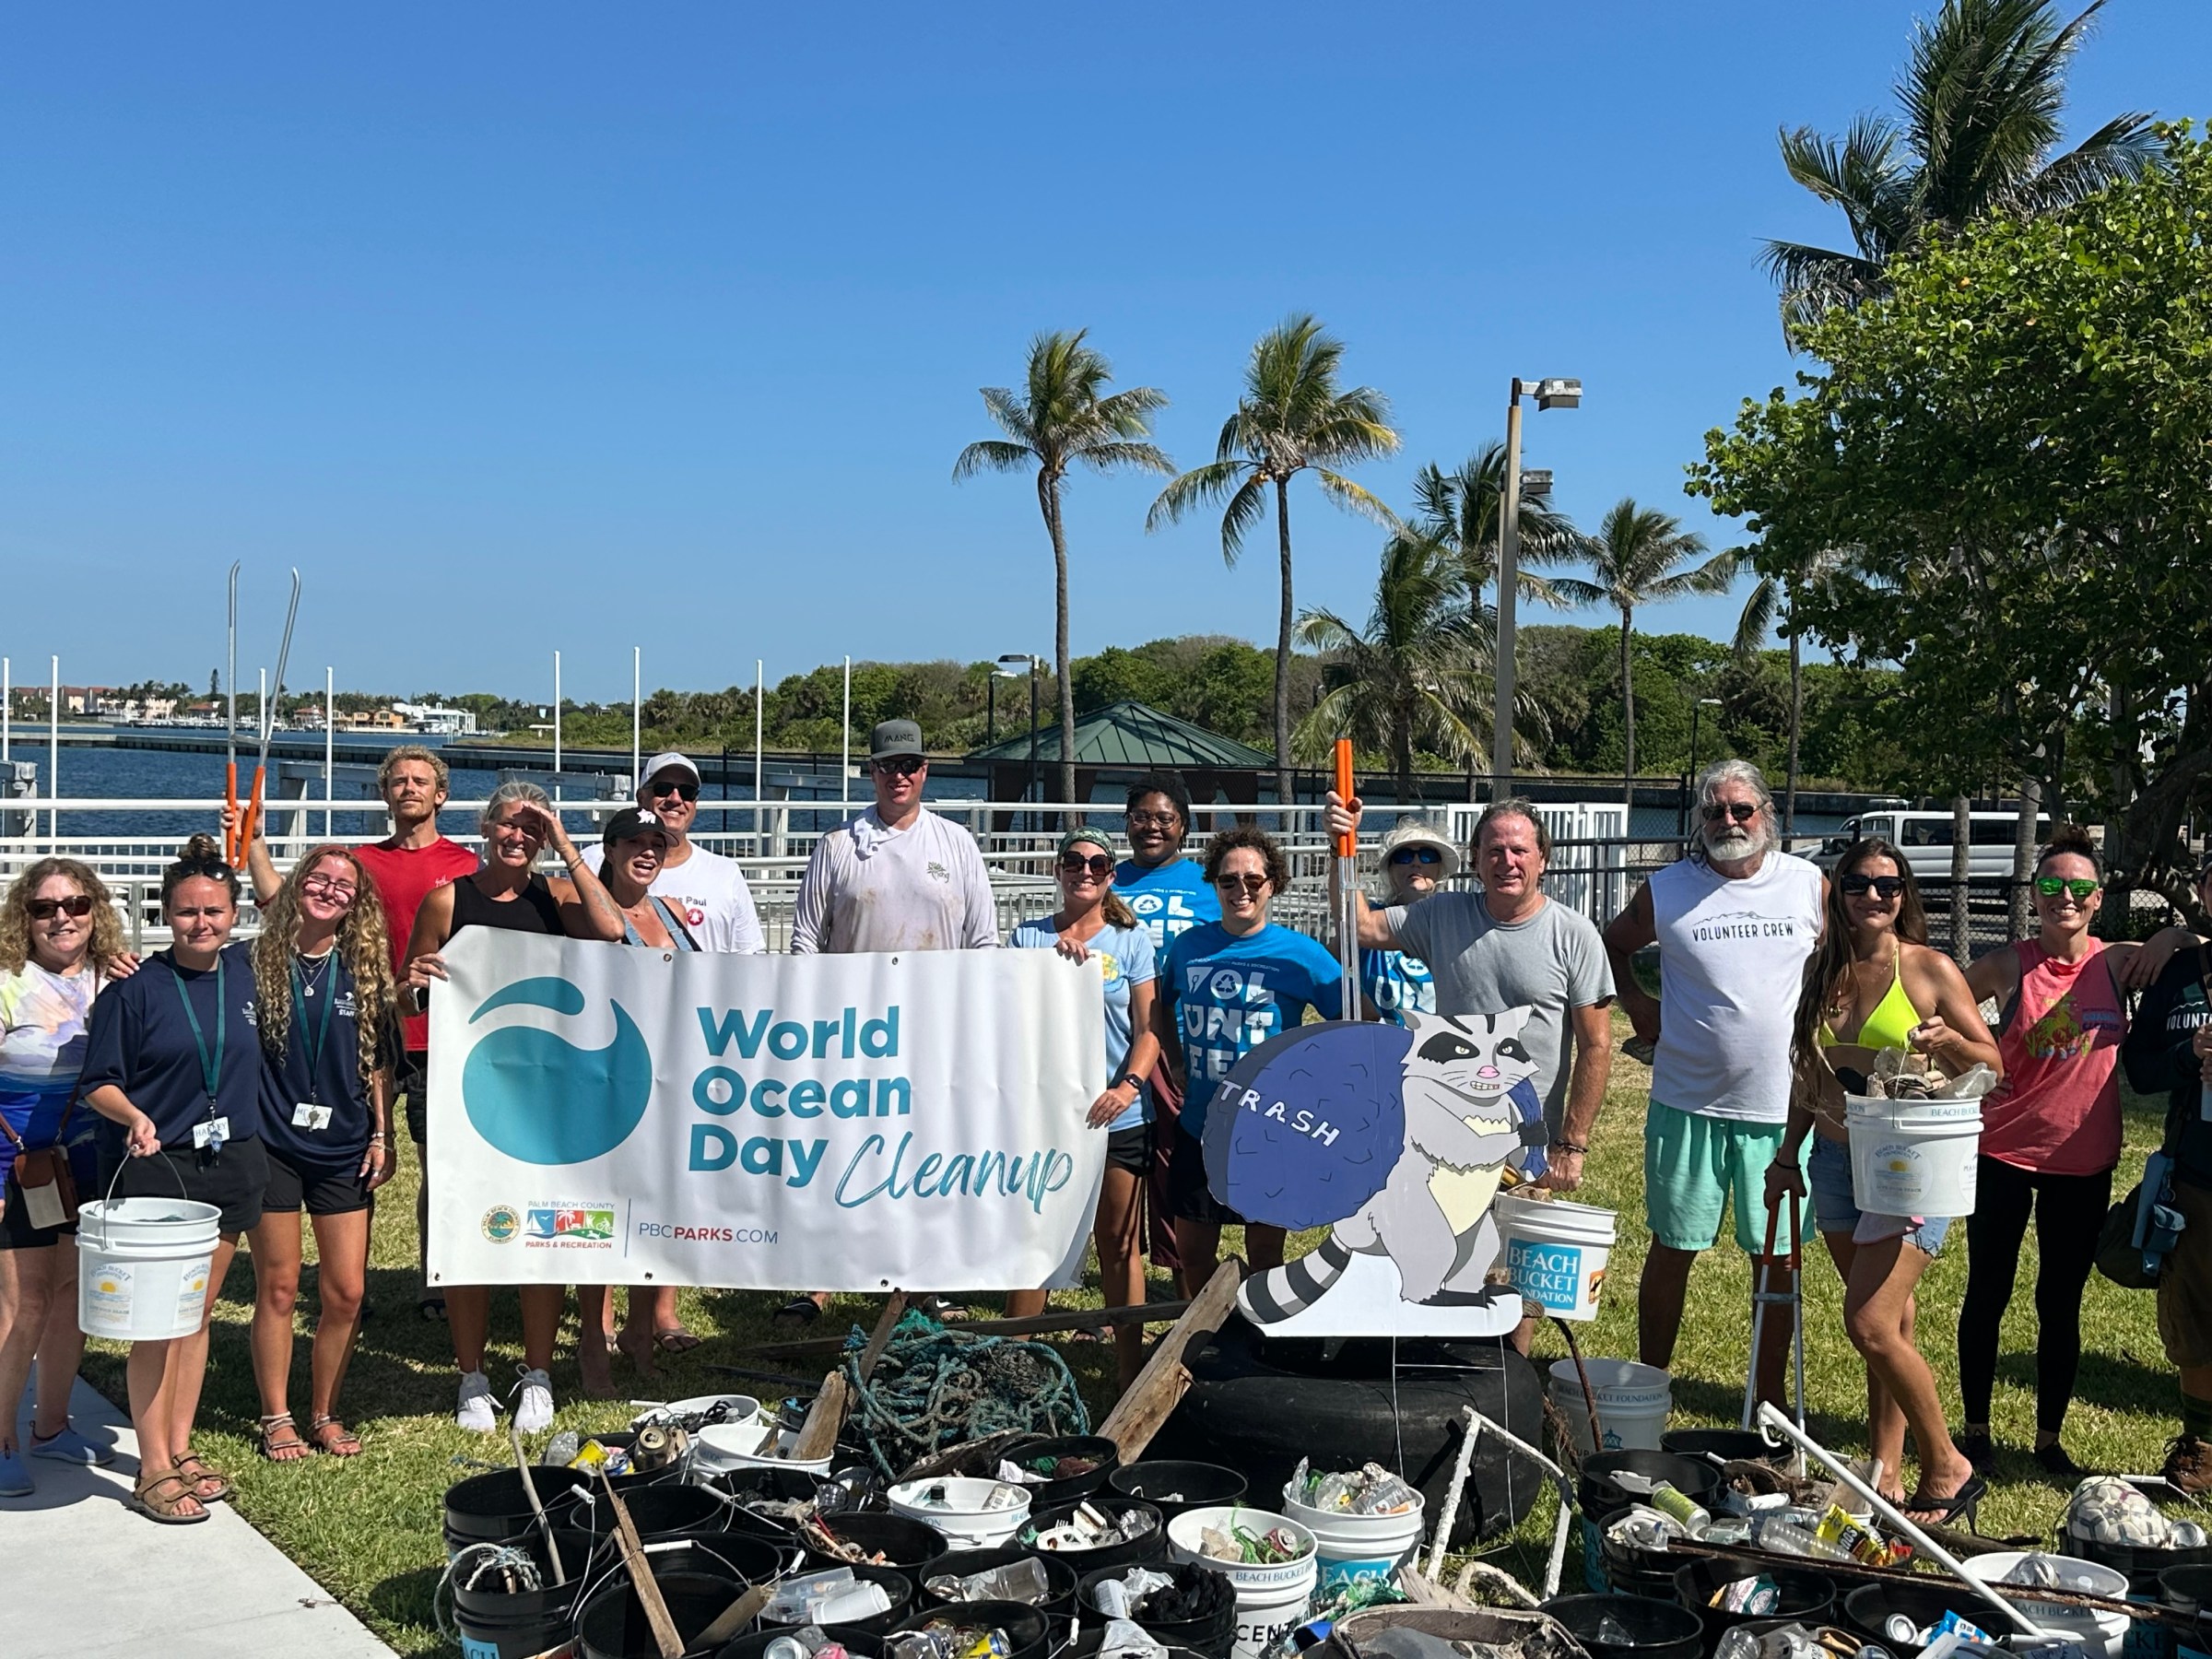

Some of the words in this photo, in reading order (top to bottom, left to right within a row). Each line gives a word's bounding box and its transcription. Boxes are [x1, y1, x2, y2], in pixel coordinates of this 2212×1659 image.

[883, 734, 915, 743] MANG
[686, 896, 707, 907] Paul
[1692, 924, 1759, 942] VOLUNTEER
[1763, 923, 1794, 937] CREW
[1186, 966, 1275, 1003] VOL
[696, 1005, 900, 1061] World
[1183, 1003, 1274, 1045] UNT
[1188, 1042, 1248, 1082] EE
[691, 1065, 912, 1120] Ocean
[1220, 1079, 1341, 1147] TRASH
[1931, 1107, 1960, 1117] BEACH
[688, 1123, 830, 1189] Day
[833, 1131, 1073, 1216] Cleanup
[528, 1200, 549, 1209] PALM
[550, 1201, 579, 1209] BEACH
[581, 1201, 616, 1209] COUNTY
[639, 1222, 779, 1245] PBCPARKS.COM
[525, 1241, 550, 1249] PARKS
[560, 1241, 612, 1250] RECREATION
[1509, 1246, 1579, 1275] BEACH
[1508, 1266, 1577, 1291] BUCKET
[1517, 1287, 1574, 1304] UNDATION
[1616, 1393, 1664, 1403] FOUNDATION
[1235, 1571, 1272, 1583] BEACH
[1273, 1567, 1304, 1582] BUCKET
